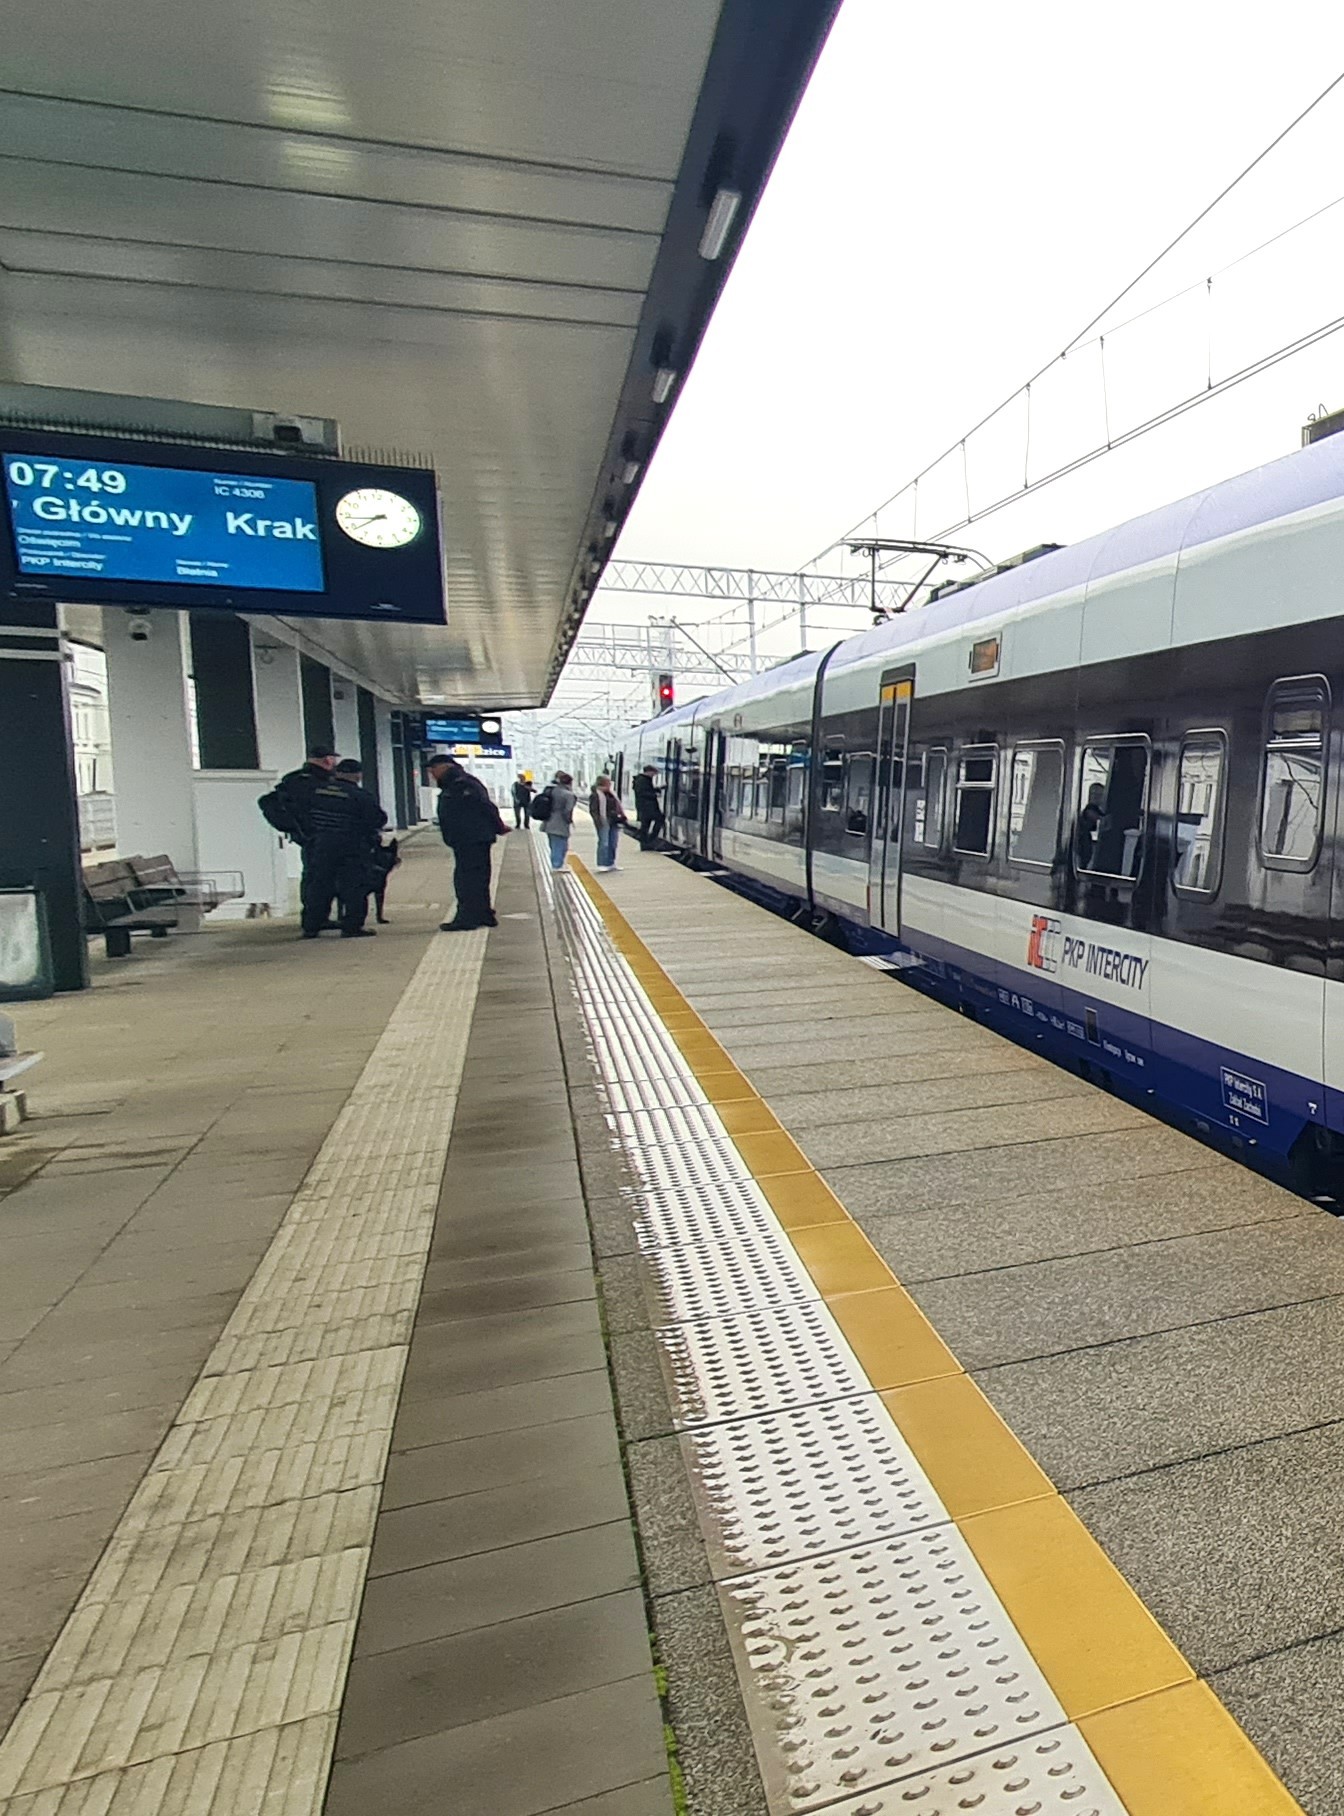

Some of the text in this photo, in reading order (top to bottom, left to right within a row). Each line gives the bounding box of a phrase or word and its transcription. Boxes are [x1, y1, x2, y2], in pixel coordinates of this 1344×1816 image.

[9, 461, 126, 494] 07:49
[214, 486, 230, 496] IC
[32, 496, 193, 536] Główny
[226, 511, 317, 540] Krak
[21, 556, 103, 571] PKP Intercity
[1062, 936, 1149, 990] PKP INTERCITY
